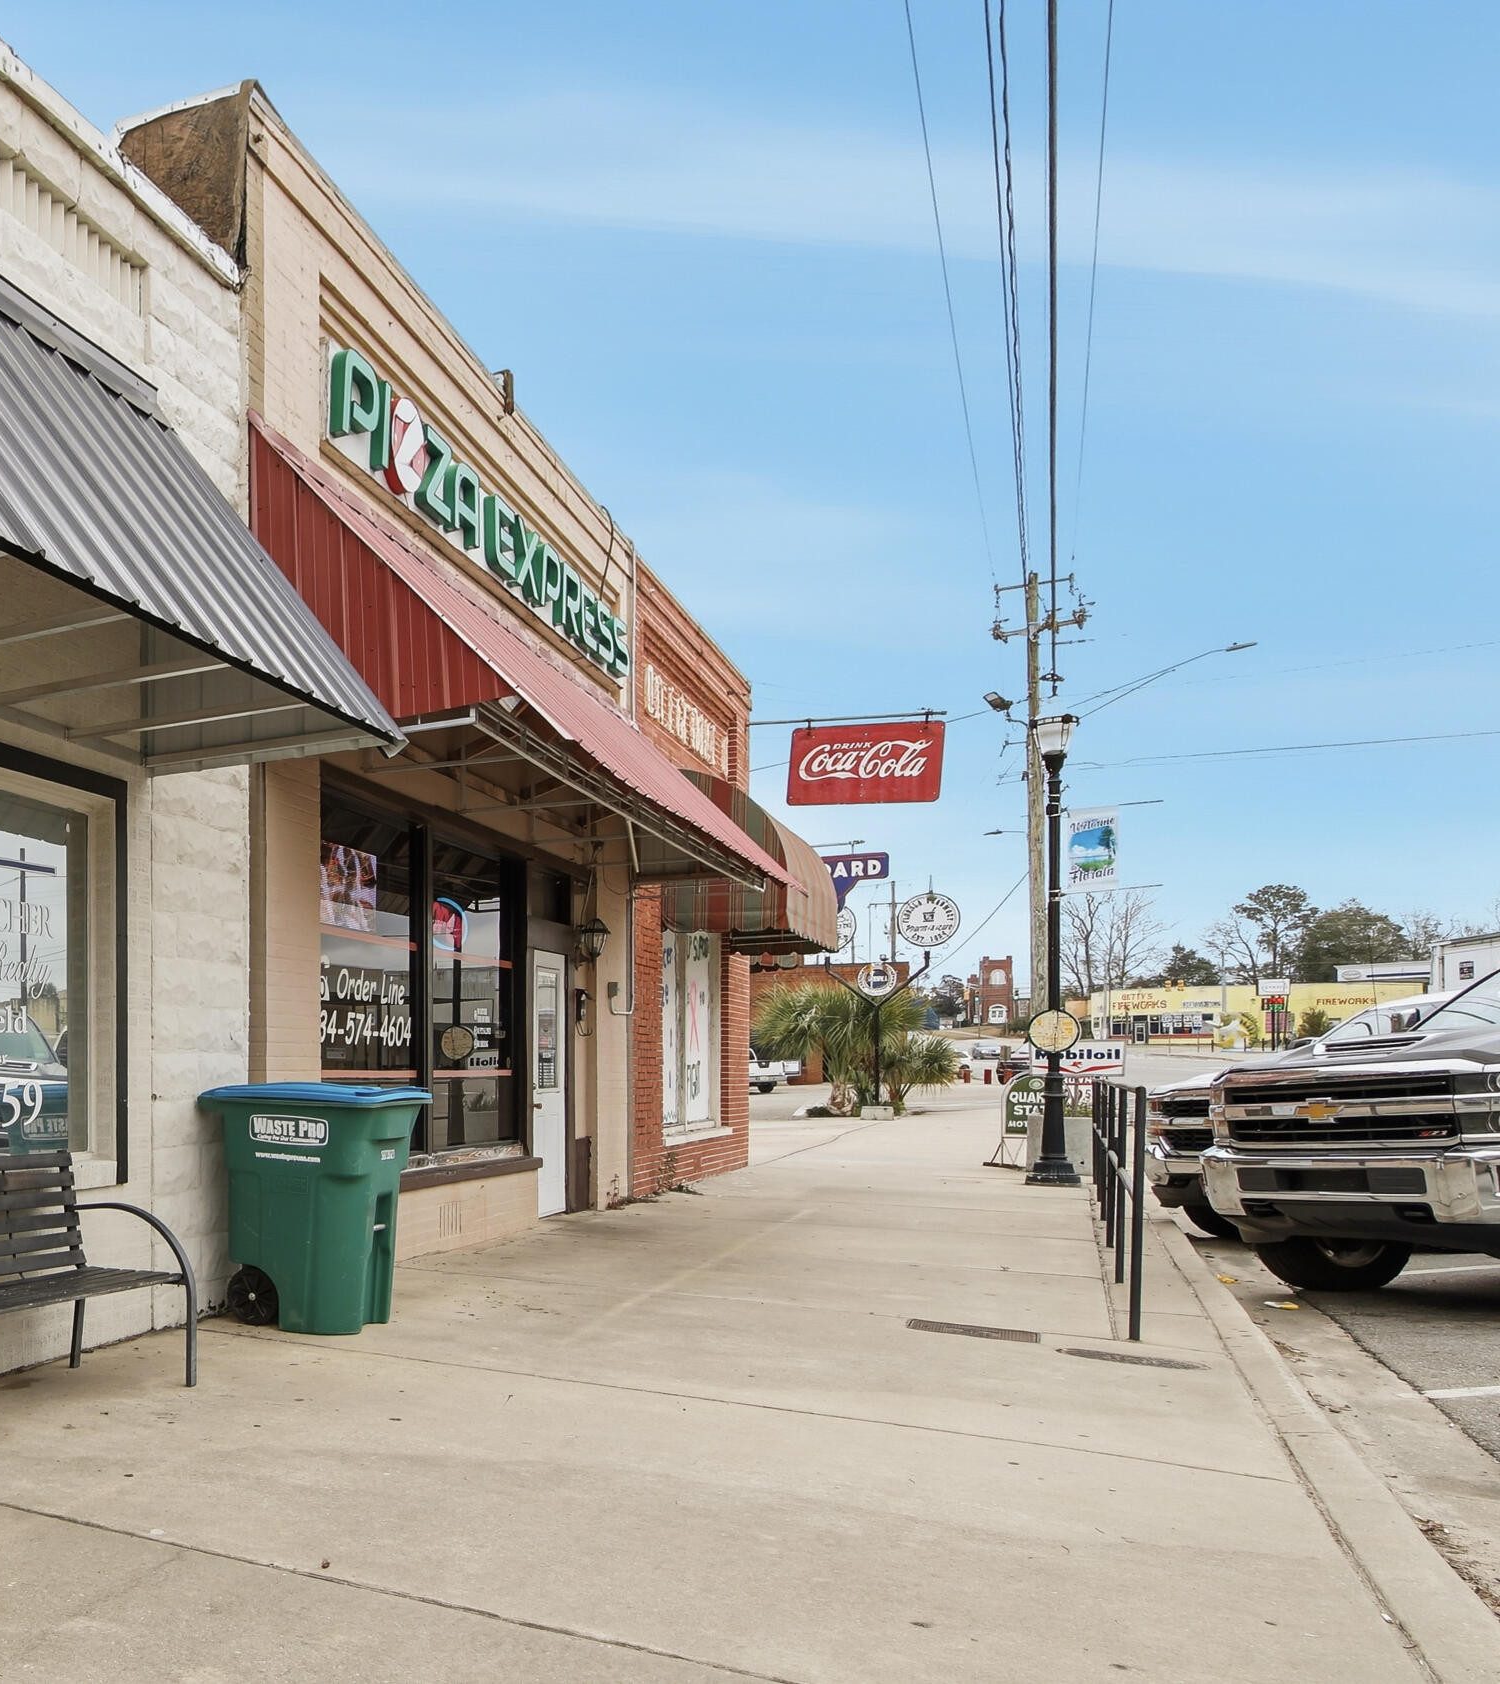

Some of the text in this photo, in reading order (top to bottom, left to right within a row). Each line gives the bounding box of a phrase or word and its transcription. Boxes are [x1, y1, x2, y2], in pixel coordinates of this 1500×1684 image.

[331, 348, 629, 679] PIZZA EXPRESS
[832, 741, 873, 750] DRINK
[799, 739, 933, 781] Coca-Cola
[337, 968, 405, 1005] Order Line
[1316, 997, 1376, 1006] FIREWORKS
[320, 1009, 412, 1047] 34-574-4604
[1035, 1049, 1120, 1060] Mbiloil
[1009, 1091, 1045, 1103] QUAK
[254, 1117, 325, 1139] WASTE PRO
